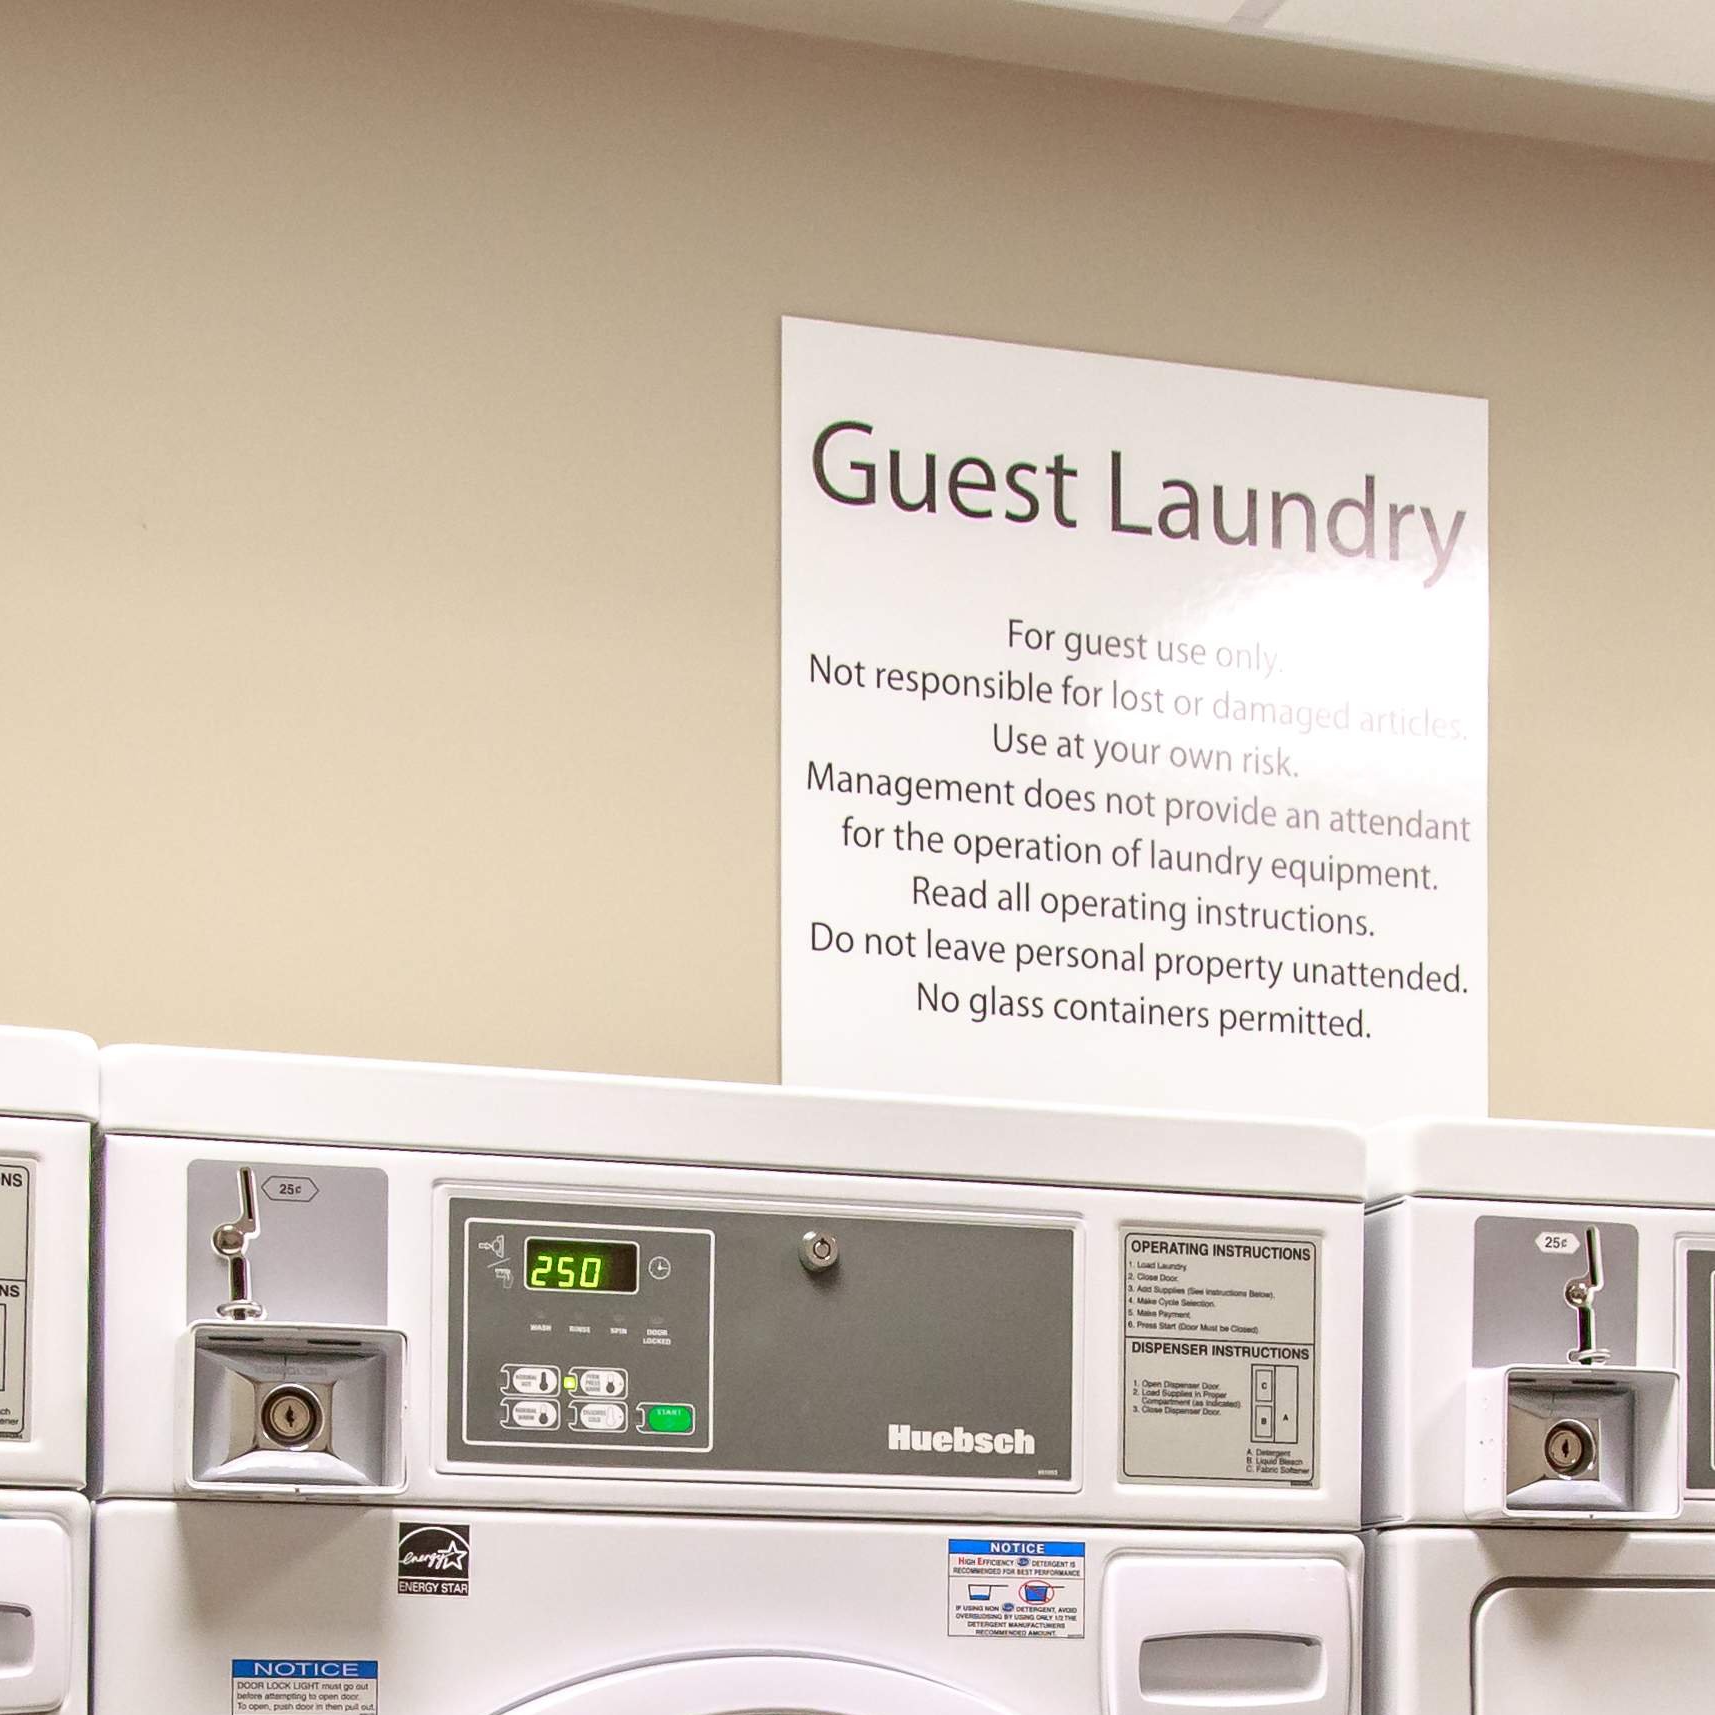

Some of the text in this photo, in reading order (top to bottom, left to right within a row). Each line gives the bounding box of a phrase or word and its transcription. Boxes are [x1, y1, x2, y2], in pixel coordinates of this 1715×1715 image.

[813, 421, 1466, 587] Guest Laundry
[1009, 619, 1282, 678] For guest use only.
[811, 654, 1467, 740] Not responsible for lost or damaged articles.
[994, 723, 1298, 778] Use at your own risk.
[808, 761, 1470, 842] Management does not provide an attendant
[842, 816, 1437, 890] for the operation of laundry equipment.
[913, 876, 1373, 936] Read all operating instructions.
[812, 922, 1467, 993] Do not leave personal property unattended.
[918, 982, 1370, 1038] No glass containers permitted.
[531, 1256, 601, 1287] 250
[1131, 1240, 1310, 1261] OPERATING INSTRUCTIONS
[1132, 1342, 1309, 1360] DISPENSER INSTRUCTIONS
[888, 1424, 1035, 1454] Huebsch
[991, 1543, 1043, 1554] NOTICE
[399, 1582, 467, 1593] ENERGY STAR
[255, 1663, 358, 1676] NOTICE
